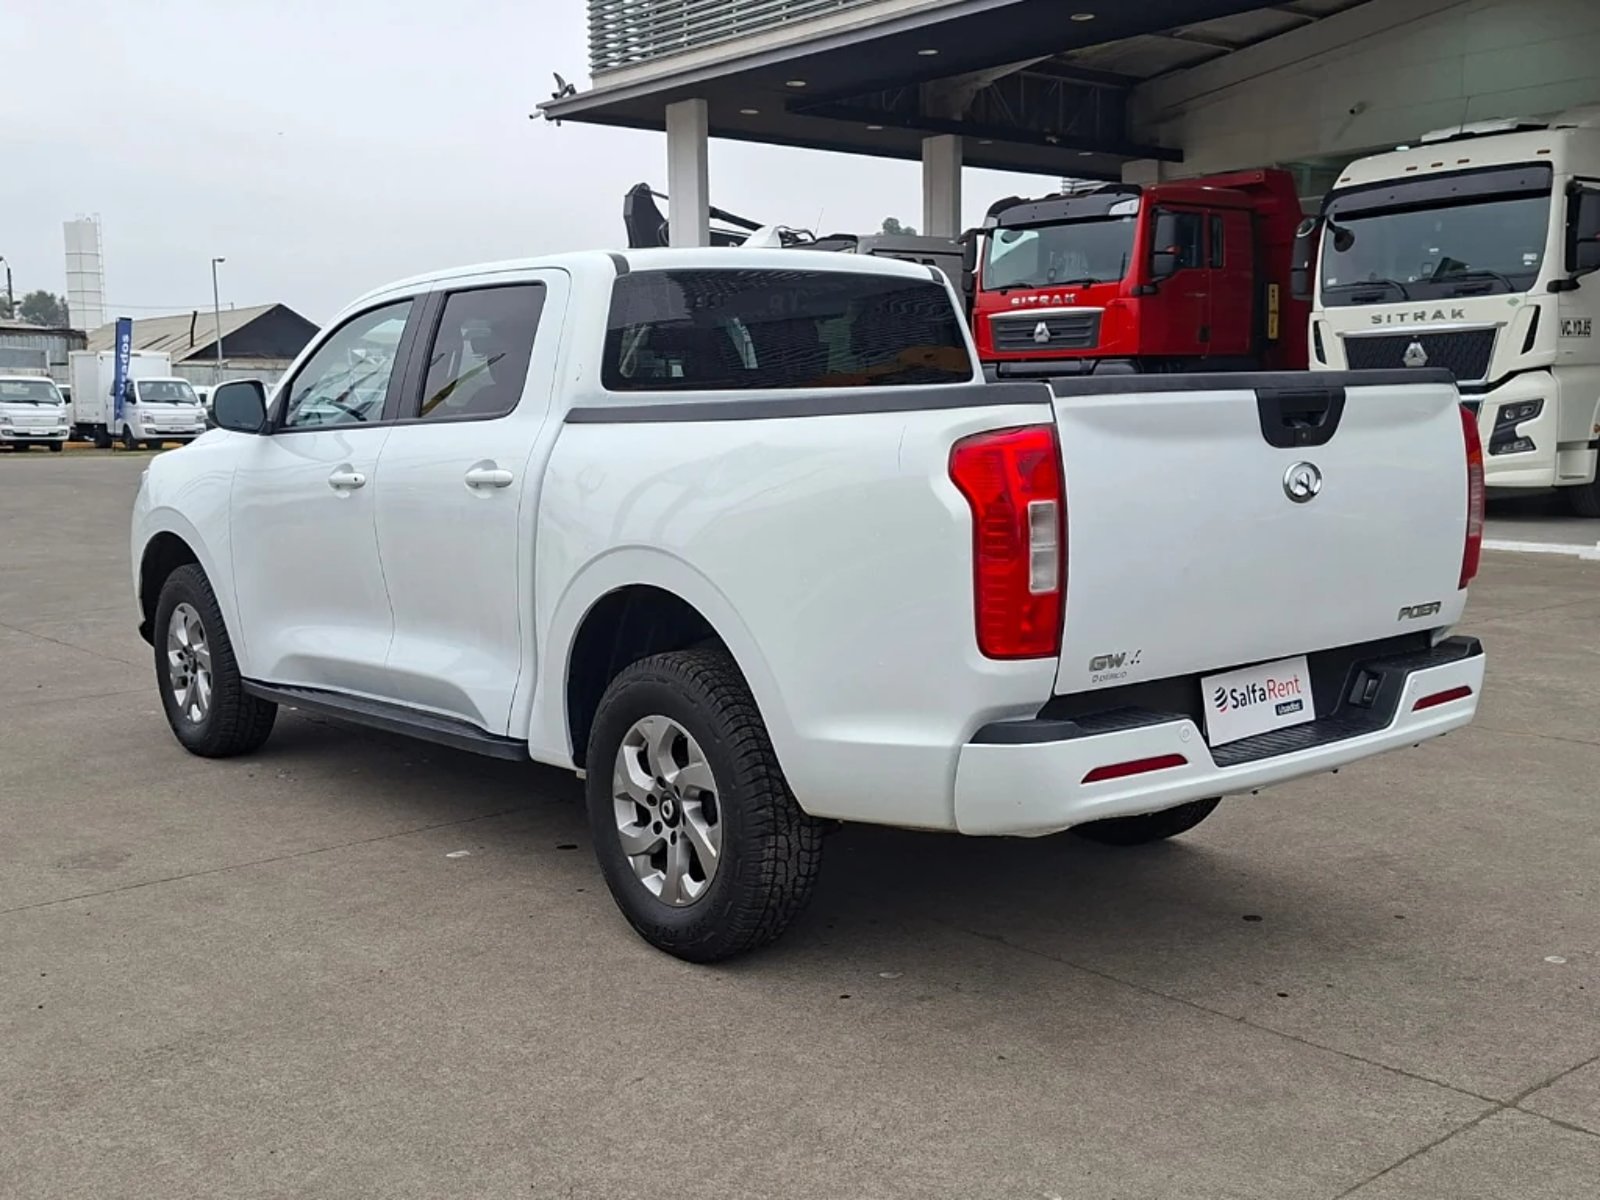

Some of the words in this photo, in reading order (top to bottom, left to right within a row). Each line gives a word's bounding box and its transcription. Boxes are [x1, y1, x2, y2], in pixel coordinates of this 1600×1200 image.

[1011, 293, 1077, 306] SITRAK
[1371, 308, 1465, 324] SITRAK
[1397, 601, 1442, 621] POER
[1230, 675, 1302, 710] SalfaRent
